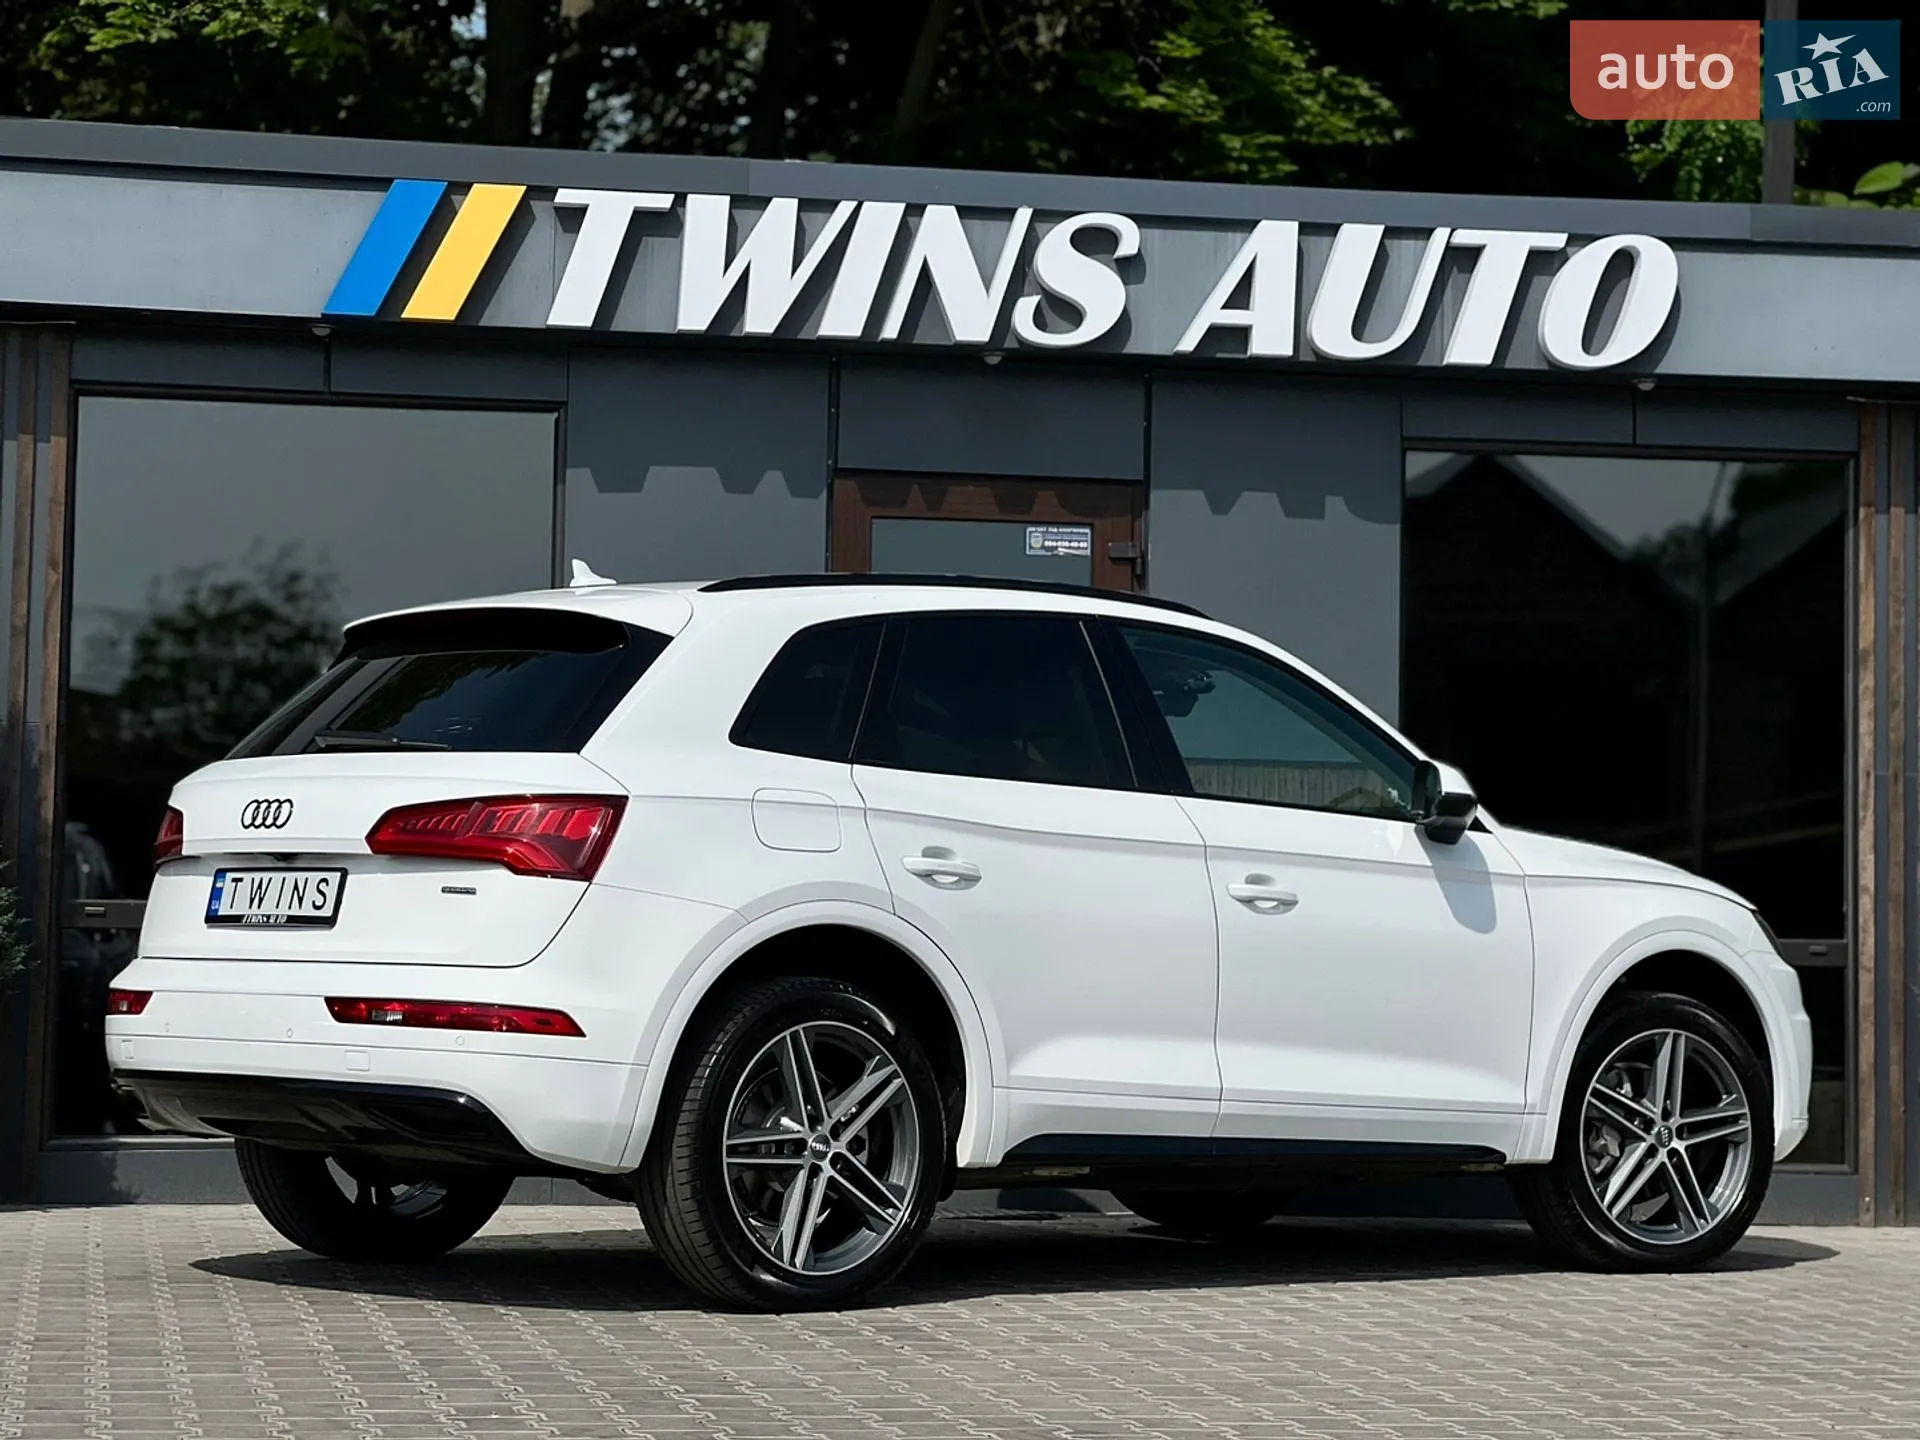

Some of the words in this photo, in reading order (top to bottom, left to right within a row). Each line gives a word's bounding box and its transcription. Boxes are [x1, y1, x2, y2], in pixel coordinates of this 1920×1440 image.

[545, 187, 1141, 349] TWINS
[1172, 218, 1680, 370] AUTO
[229, 876, 330, 911] TWINS
